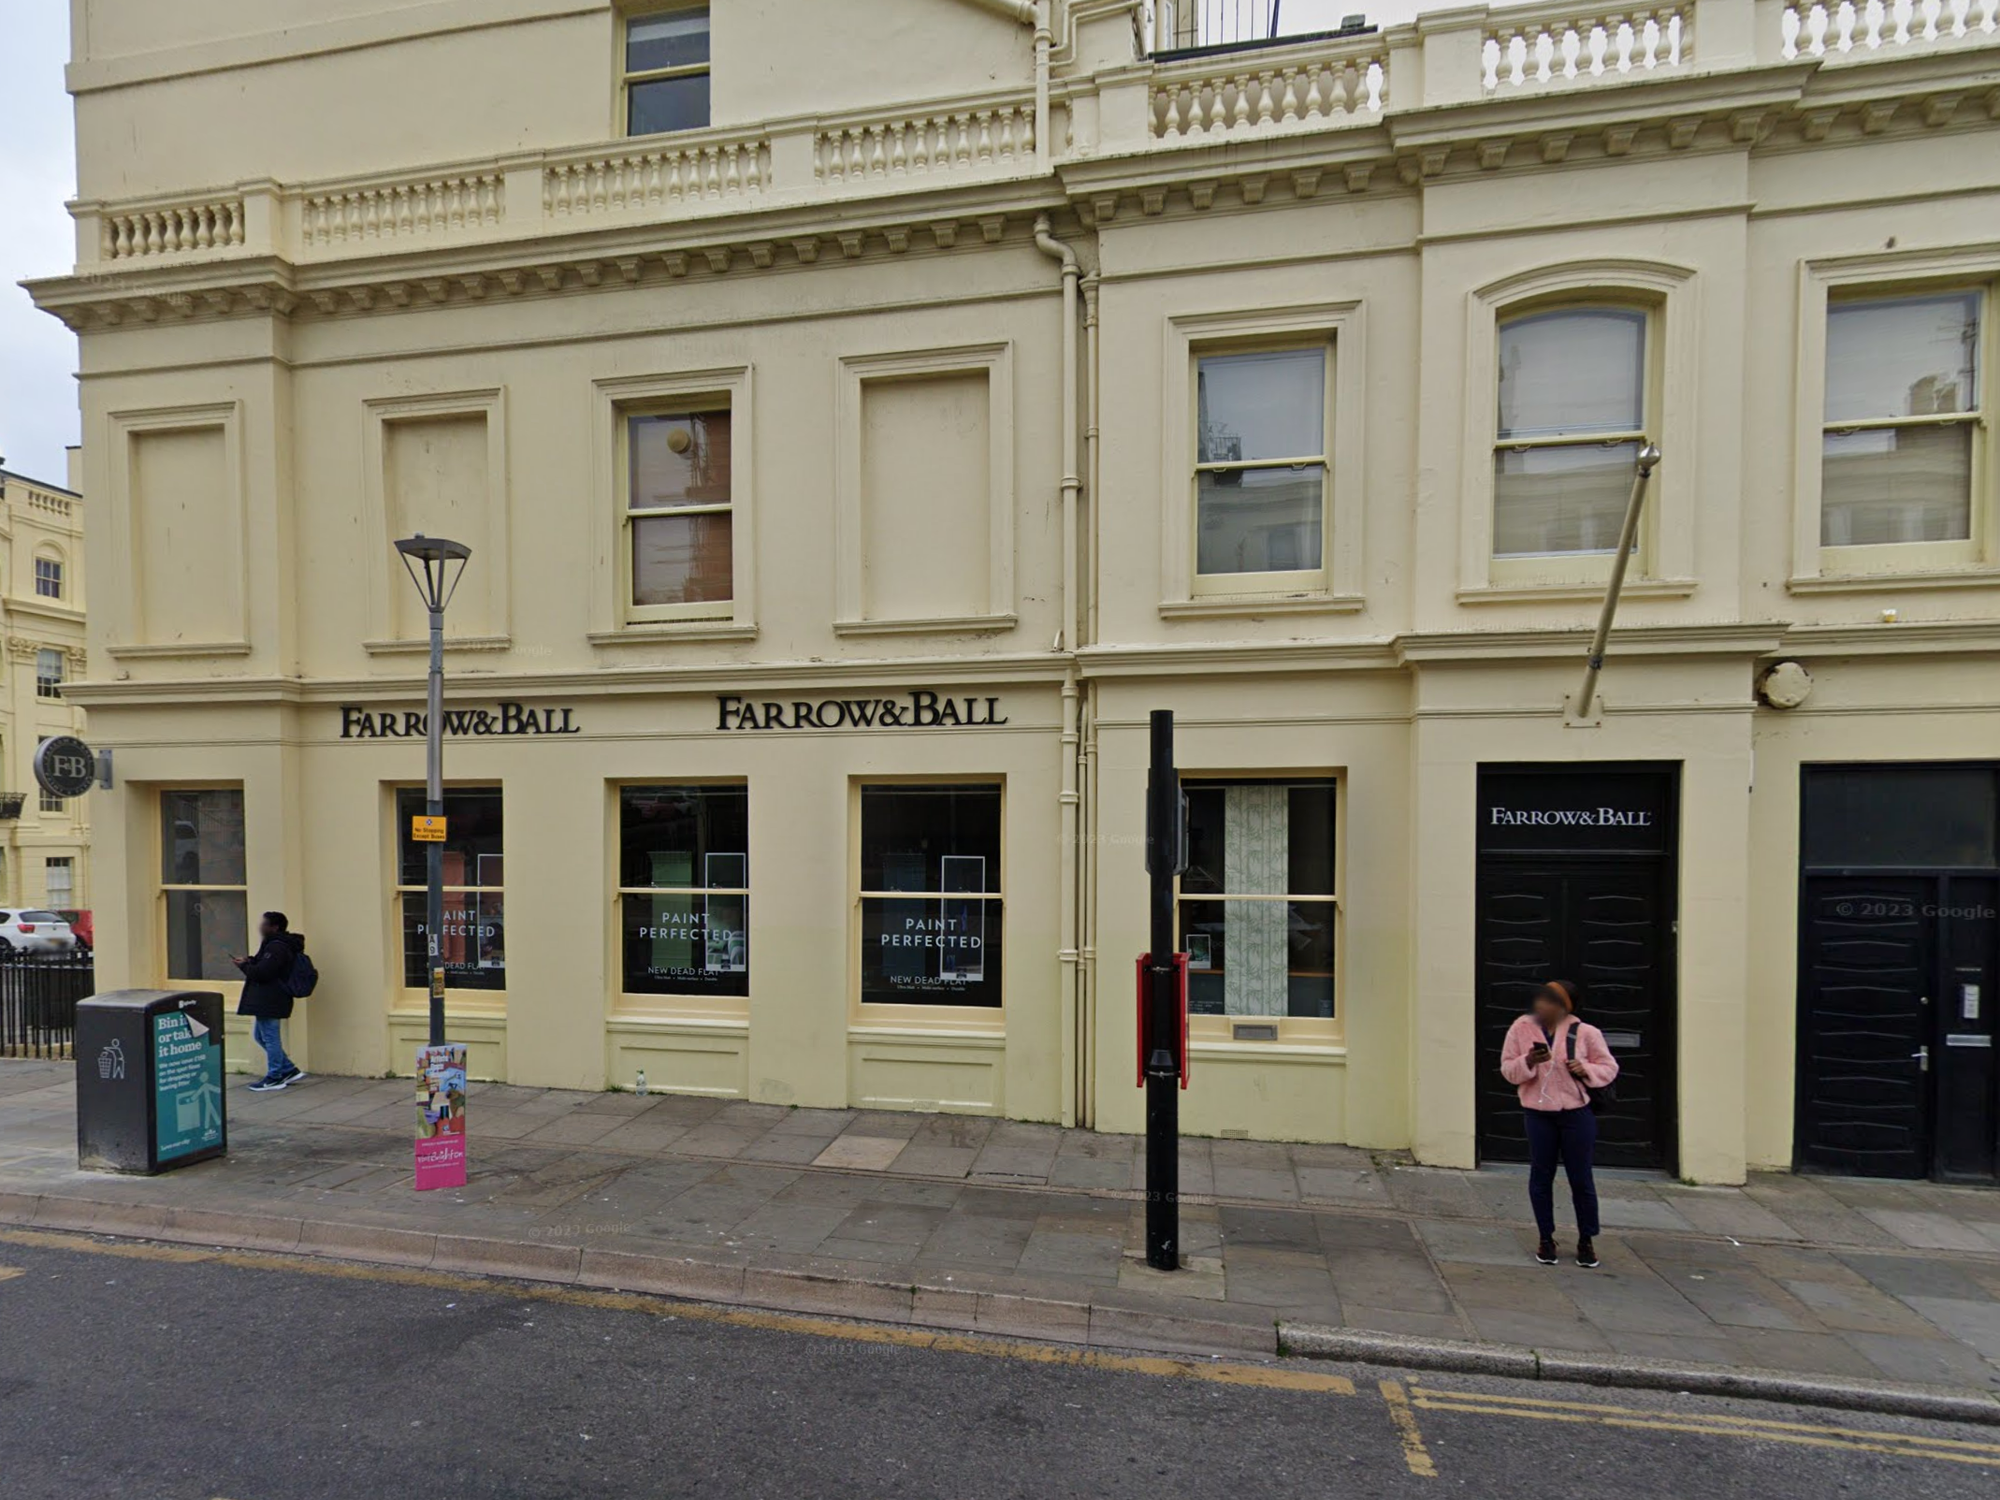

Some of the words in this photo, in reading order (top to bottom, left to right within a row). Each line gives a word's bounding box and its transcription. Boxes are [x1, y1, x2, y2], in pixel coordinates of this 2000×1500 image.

[443, 910, 476, 920] AINT
[662, 912, 710, 924] PAINT
[905, 918, 957, 931] PAINT
[640, 927, 733, 941] PERFECTED
[881, 934, 981, 949] PERFECTED
[445, 962, 465, 970] DEAD
[670, 967, 695, 976] DEAD
[890, 975, 911, 983] NEW
[914, 976, 941, 985] DEAD
[158, 1017, 178, 1030] Bin
[158, 1034, 171, 1043] or
[173, 1027, 192, 1041] tak
[158, 1046, 168, 1057] it
[170, 1041, 202, 1055] home
